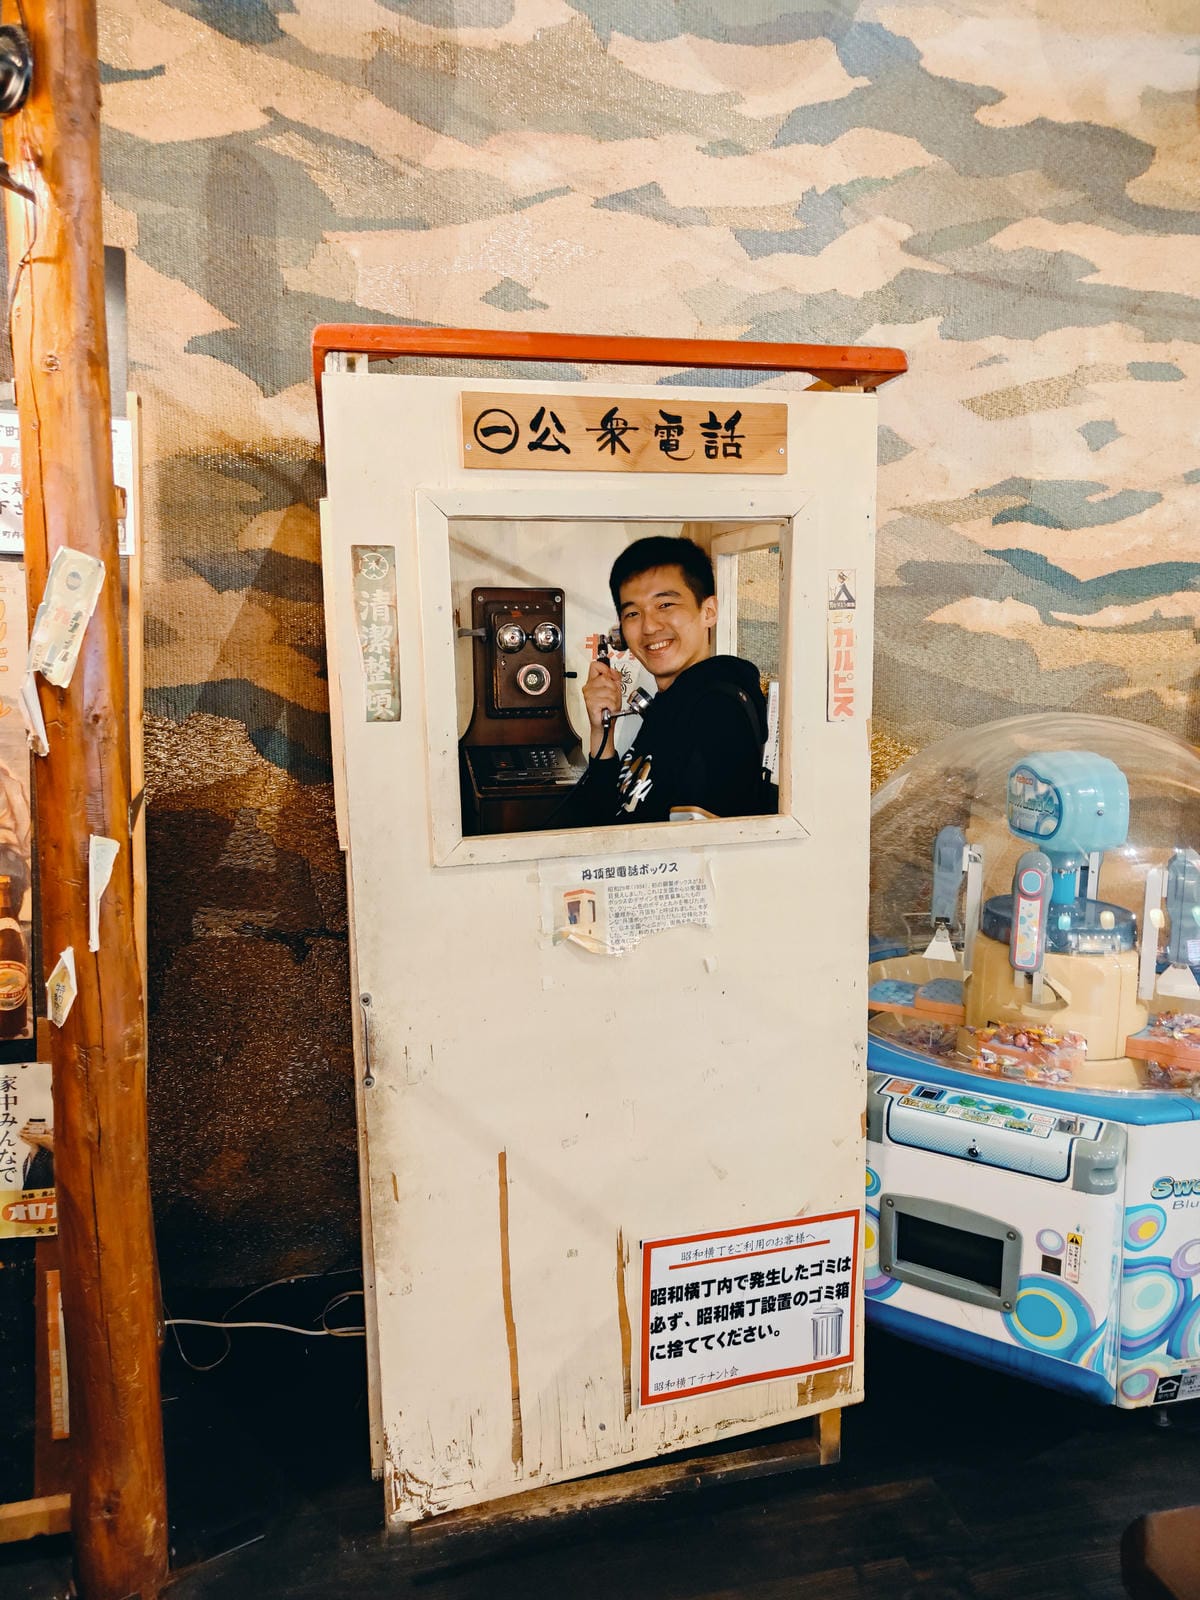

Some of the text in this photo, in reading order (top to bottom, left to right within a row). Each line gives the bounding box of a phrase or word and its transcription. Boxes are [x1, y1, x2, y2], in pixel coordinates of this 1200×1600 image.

[528, 406, 746, 461] 公衆電話
[833, 627, 854, 717] カルピス
[581, 862, 679, 881] 丹頂型電話ボックス
[0, 1075, 18, 1182] 家中みんなで
[681, 1232, 816, 1261] 昭和横丁をご利用のお客様へ
[650, 1256, 851, 1306] 昭和横丁内で発生したゴミは
[650, 1281, 850, 1335] 必ず、昭和横丁設置のゴミ箱
[650, 1324, 780, 1361] に捨ててください。
[654, 1366, 739, 1392] 昭和横丁テナント会
